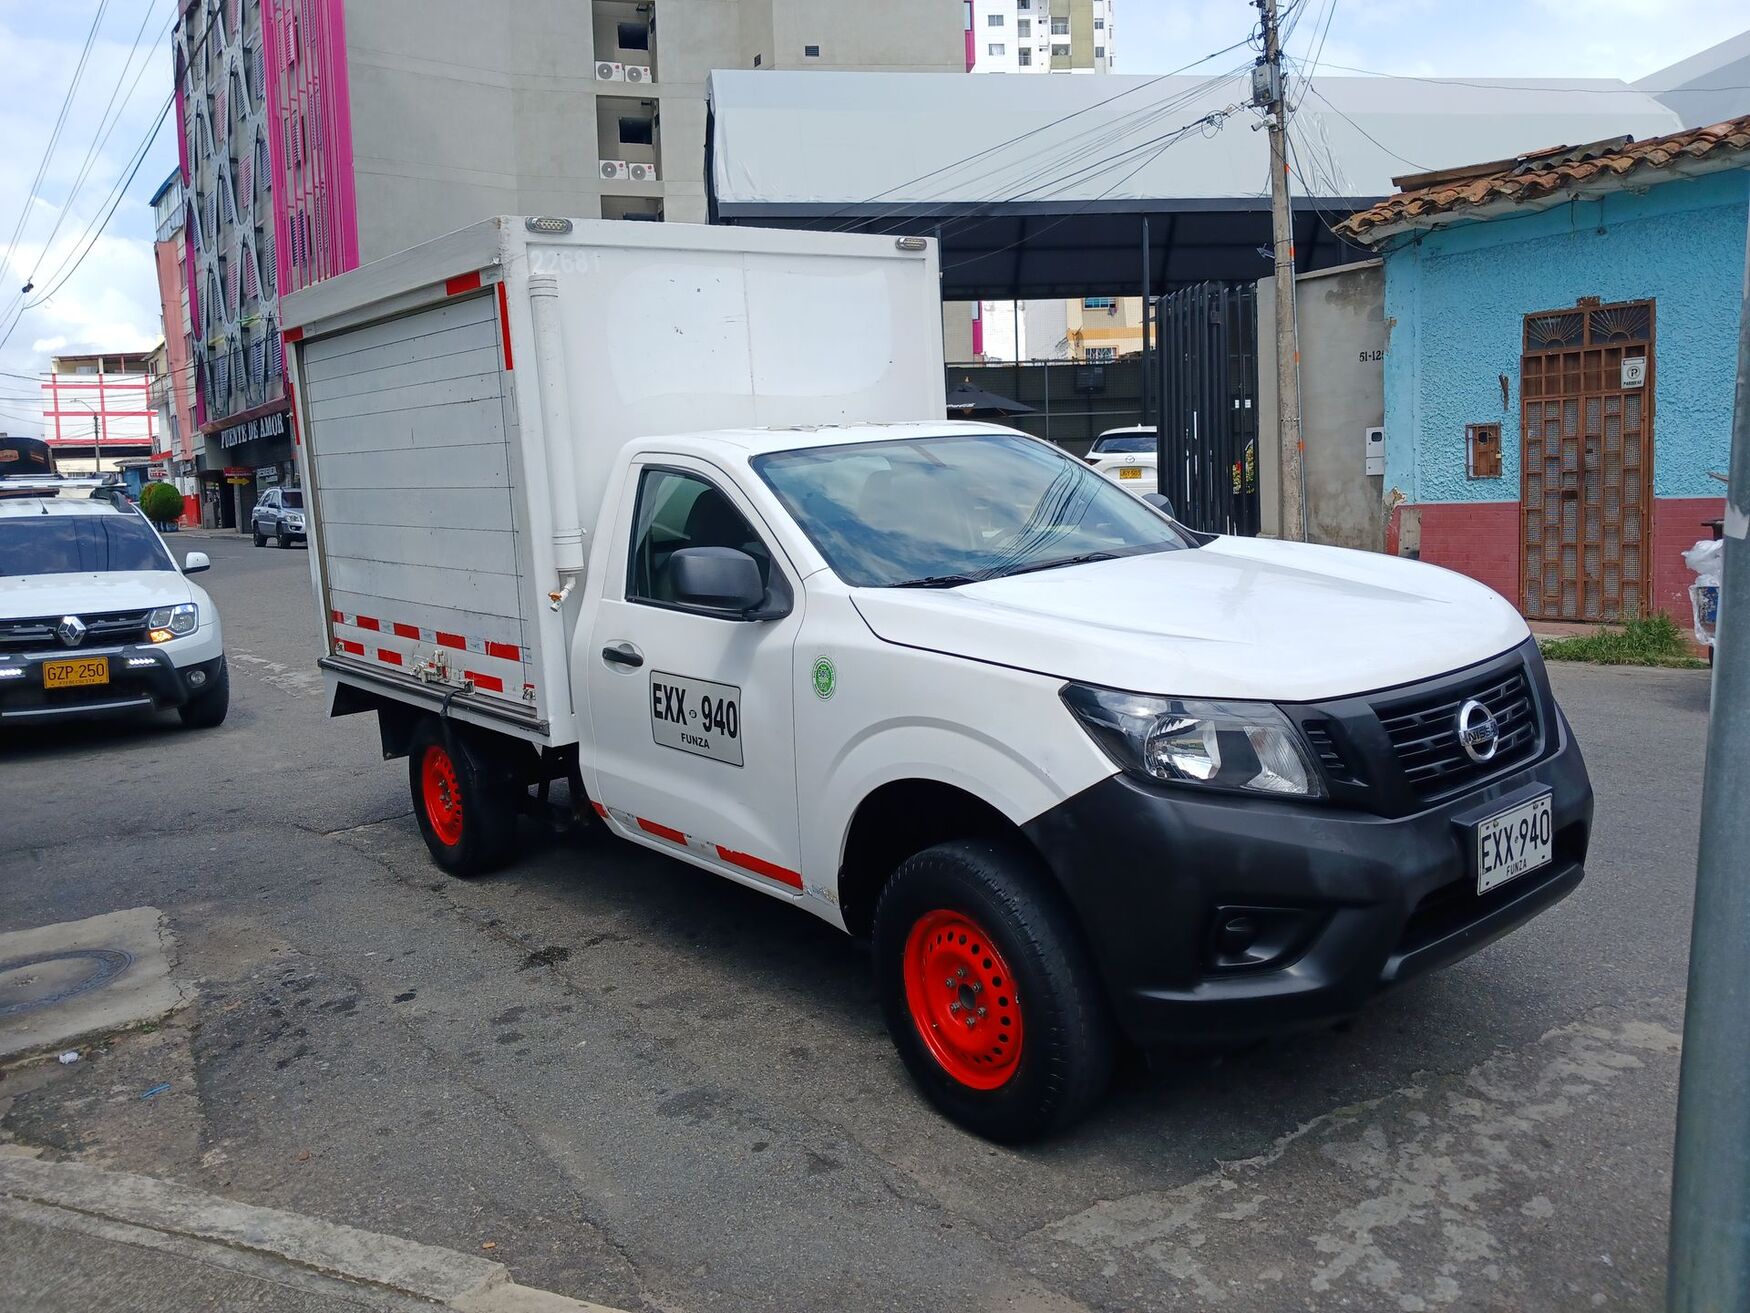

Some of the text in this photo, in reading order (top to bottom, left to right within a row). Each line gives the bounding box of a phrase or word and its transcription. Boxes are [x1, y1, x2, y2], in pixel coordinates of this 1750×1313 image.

[247, 420, 259, 440] DE
[260, 413, 284, 438] AMOR
[47, 663, 105, 680] GZP 250
[653, 682, 738, 739] EXX 940
[681, 733, 710, 749] FUNZA
[1482, 809, 1550, 875] EXX 940
[1507, 858, 1527, 877] FUNZA
